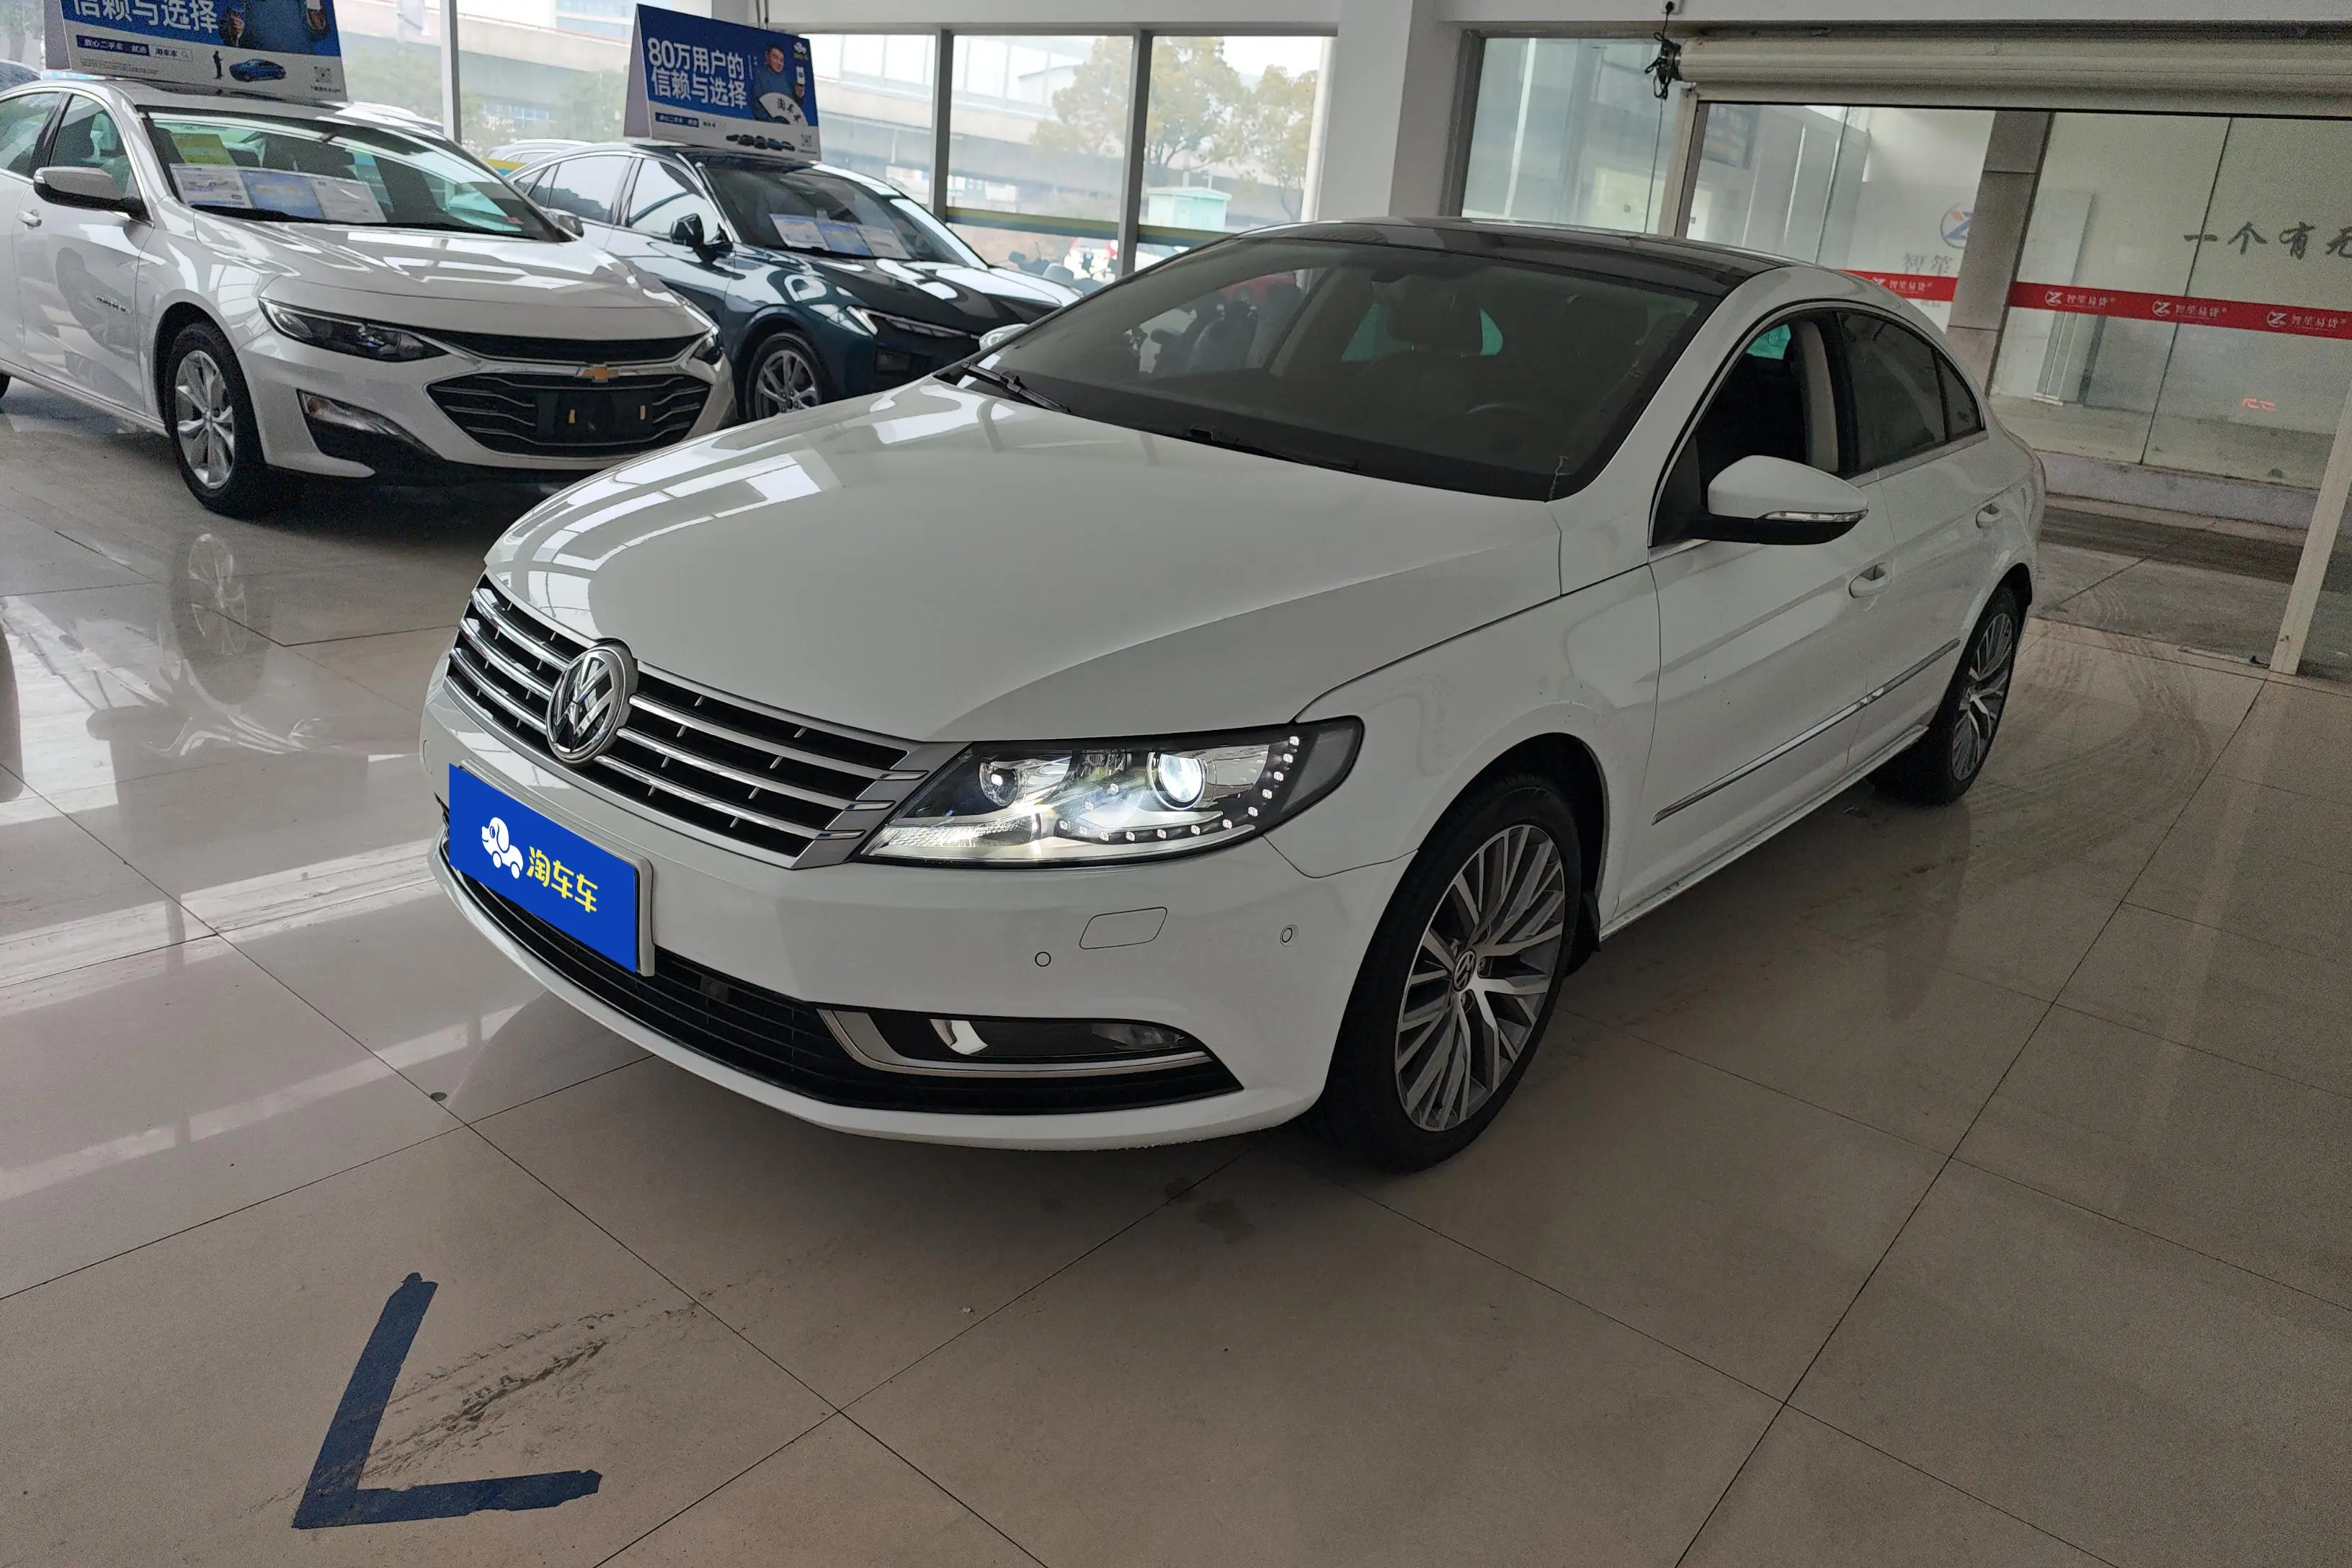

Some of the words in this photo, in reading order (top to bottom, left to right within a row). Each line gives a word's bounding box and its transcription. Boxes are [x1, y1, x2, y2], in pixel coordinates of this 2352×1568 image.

[648, 37, 744, 80] 80万用户的
[651, 66, 747, 109] 信赖与选择
